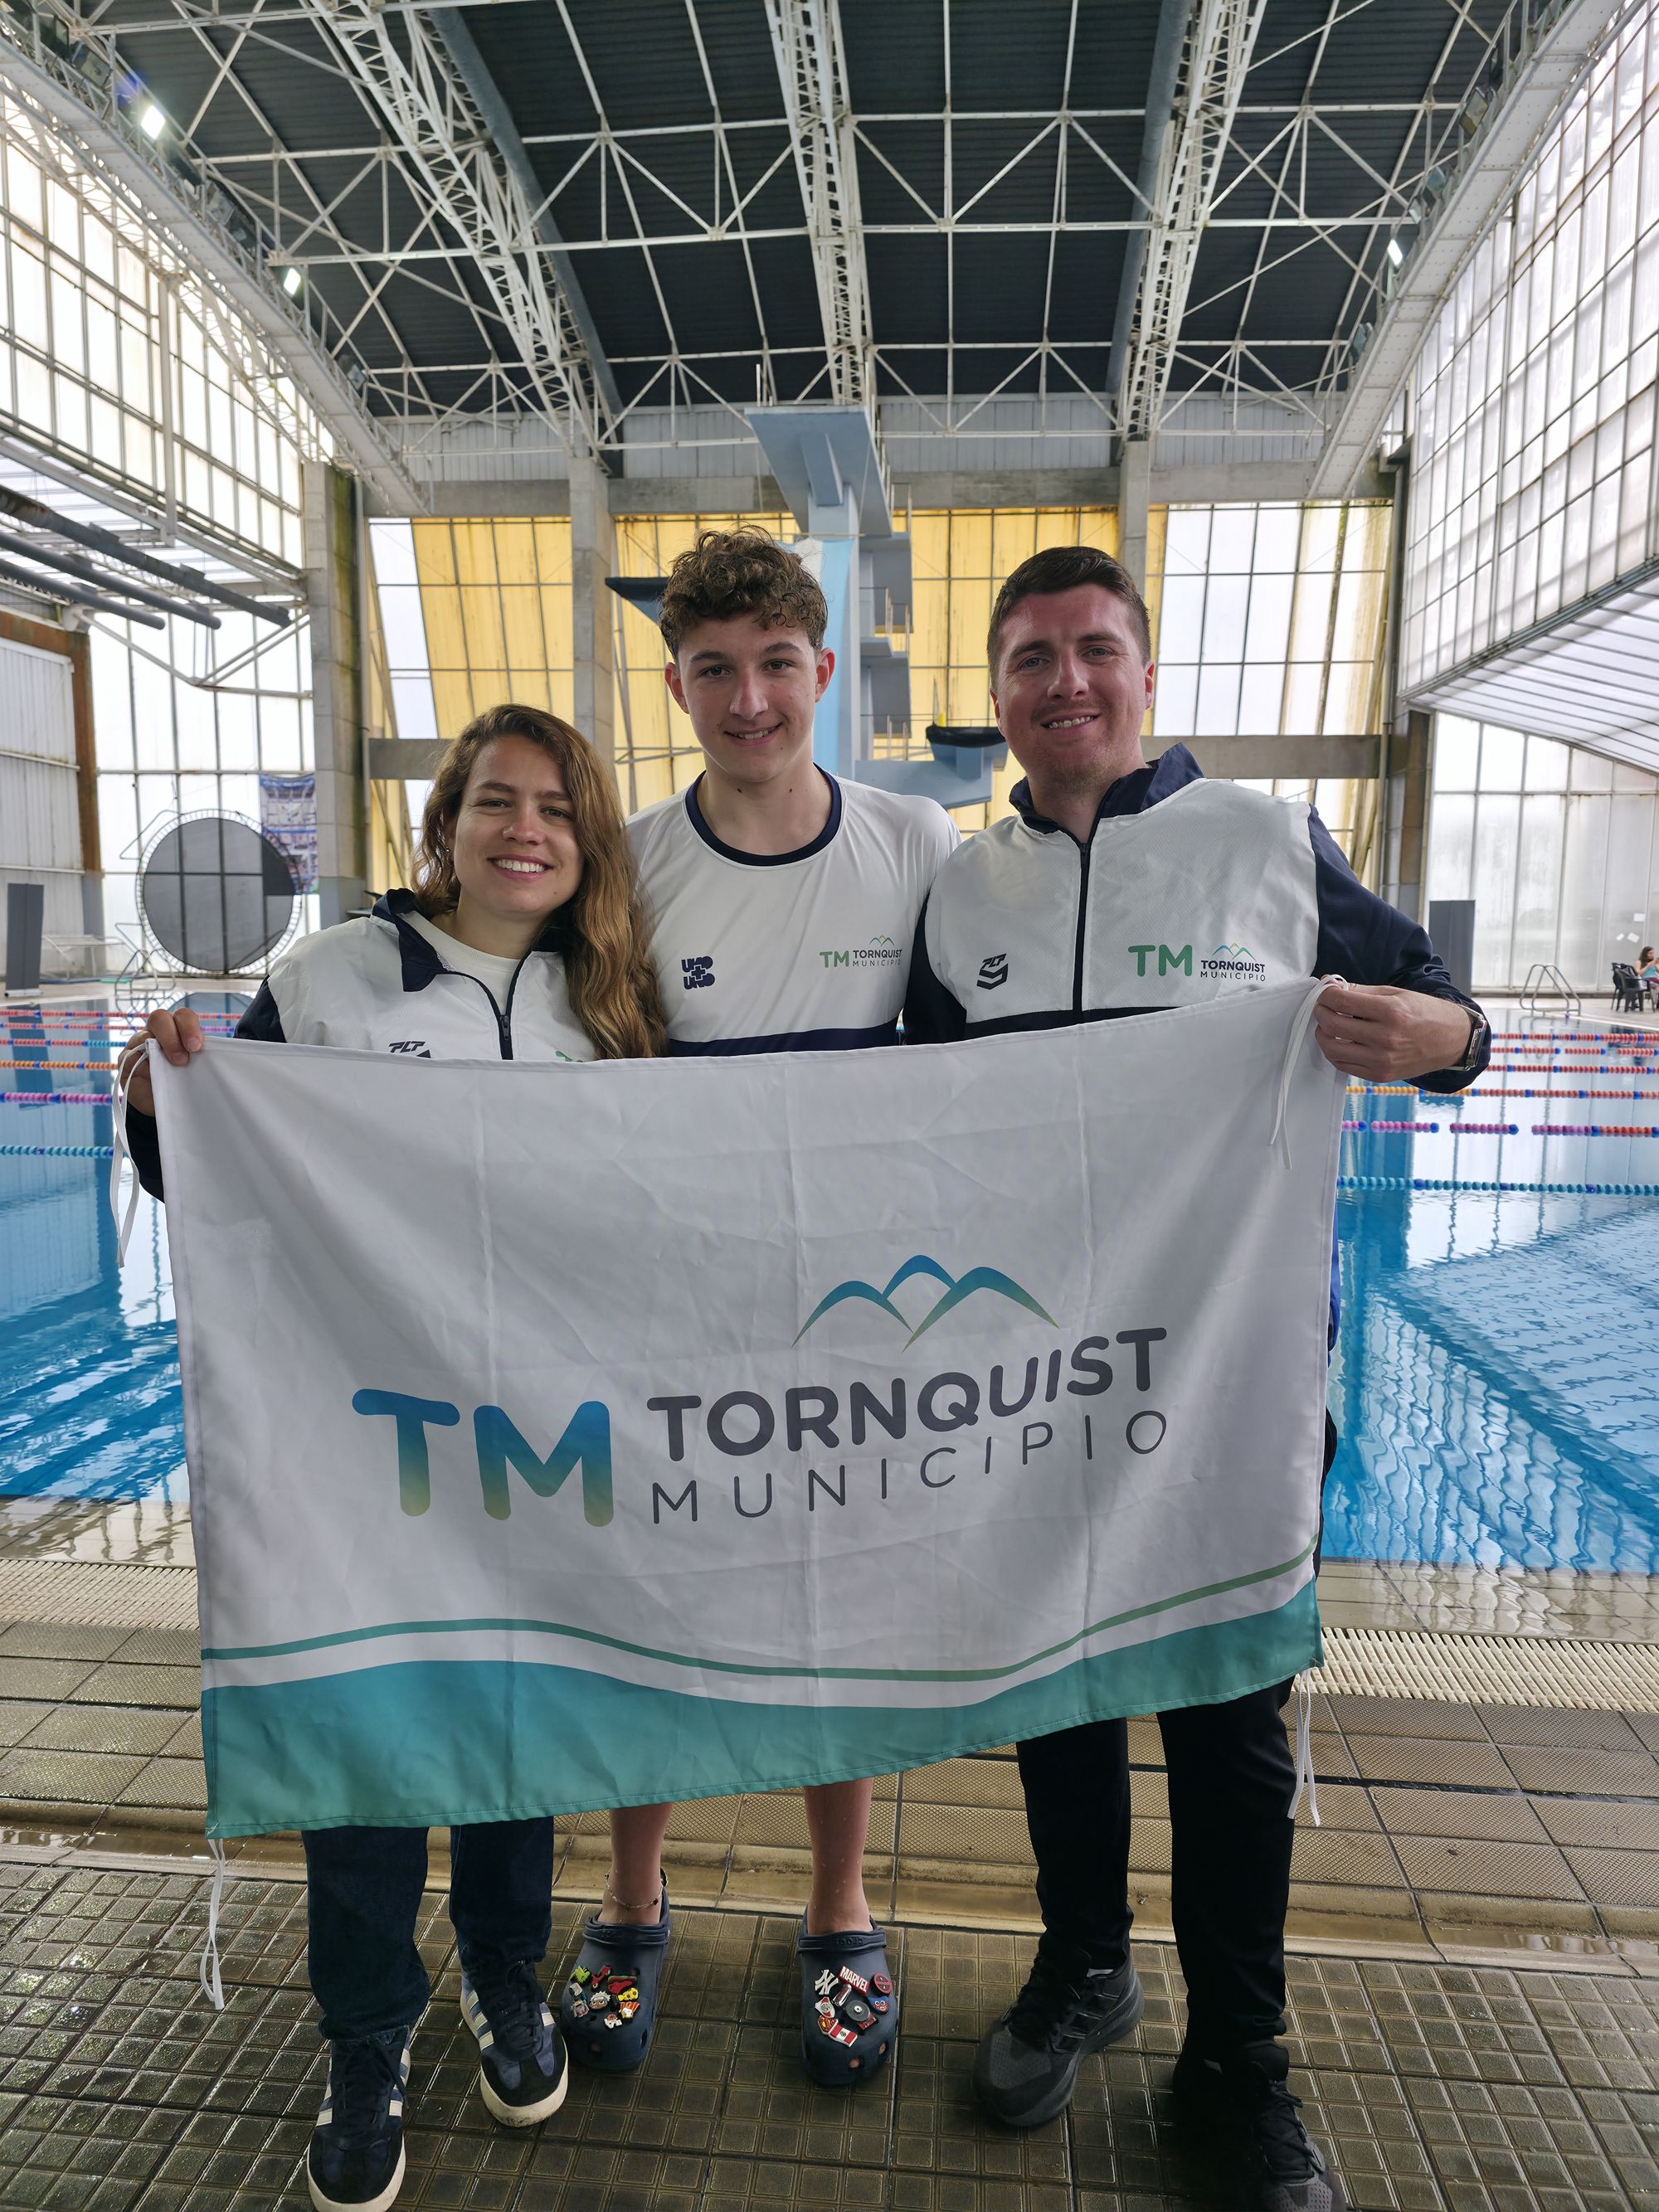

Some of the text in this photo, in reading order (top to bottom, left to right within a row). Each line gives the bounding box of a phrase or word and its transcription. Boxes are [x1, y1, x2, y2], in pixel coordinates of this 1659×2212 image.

[819, 950, 849, 968] TM
[852, 959, 902, 968] MUNICIPIO
[853, 949, 902, 959] TORNQUIST
[1127, 944, 1193, 977] TM
[1200, 960, 1266, 973] TORNQUIST
[1200, 970, 1266, 982] MUNICIPIO
[647, 1327, 1168, 1462] TORNQUIST
[352, 1388, 614, 1528] TM
[653, 1410, 1167, 1524] MUNICIPIO
[839, 1966, 869, 1993] MARVEL
